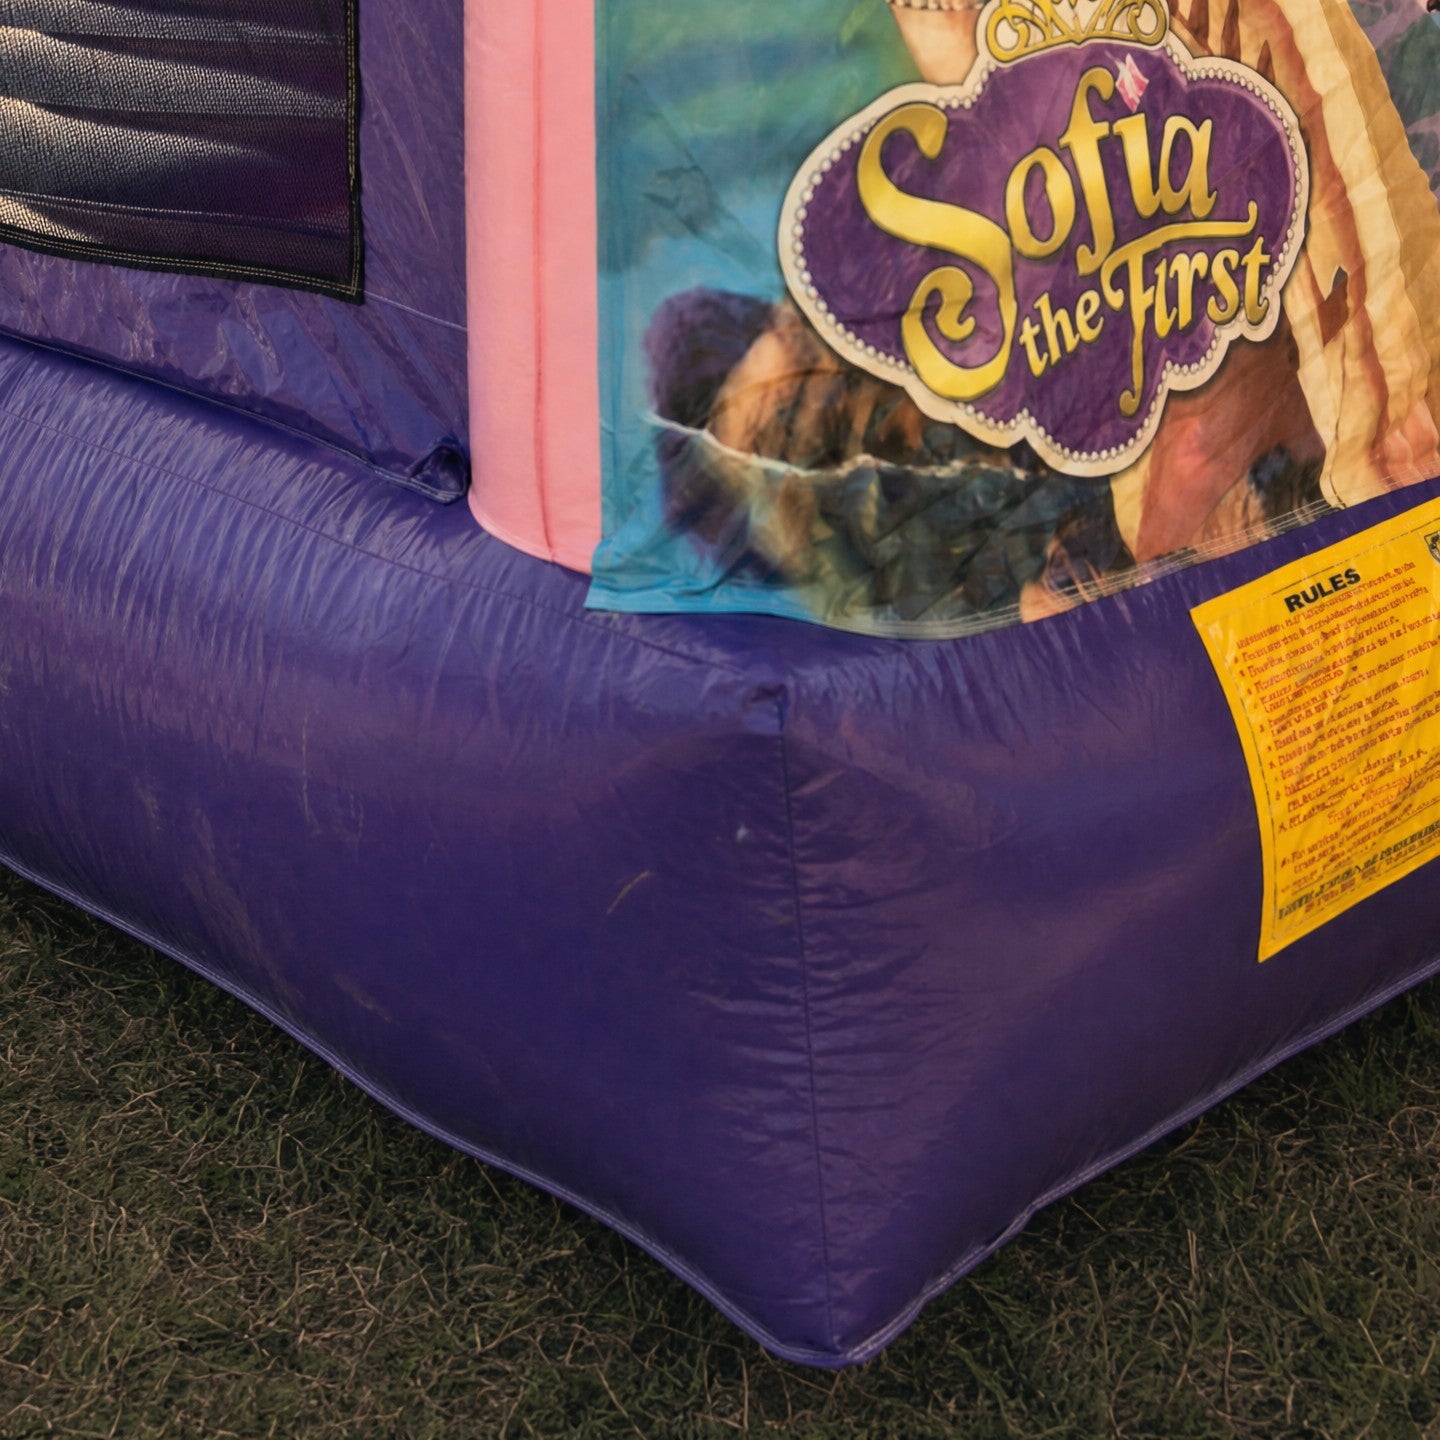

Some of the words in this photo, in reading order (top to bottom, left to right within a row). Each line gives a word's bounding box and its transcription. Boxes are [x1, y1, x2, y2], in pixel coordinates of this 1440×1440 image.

[857, 66, 1218, 401] Sofia
[1019, 289, 1104, 377] the
[1100, 200, 1273, 417] First
[1284, 568, 1362, 613] RULES
